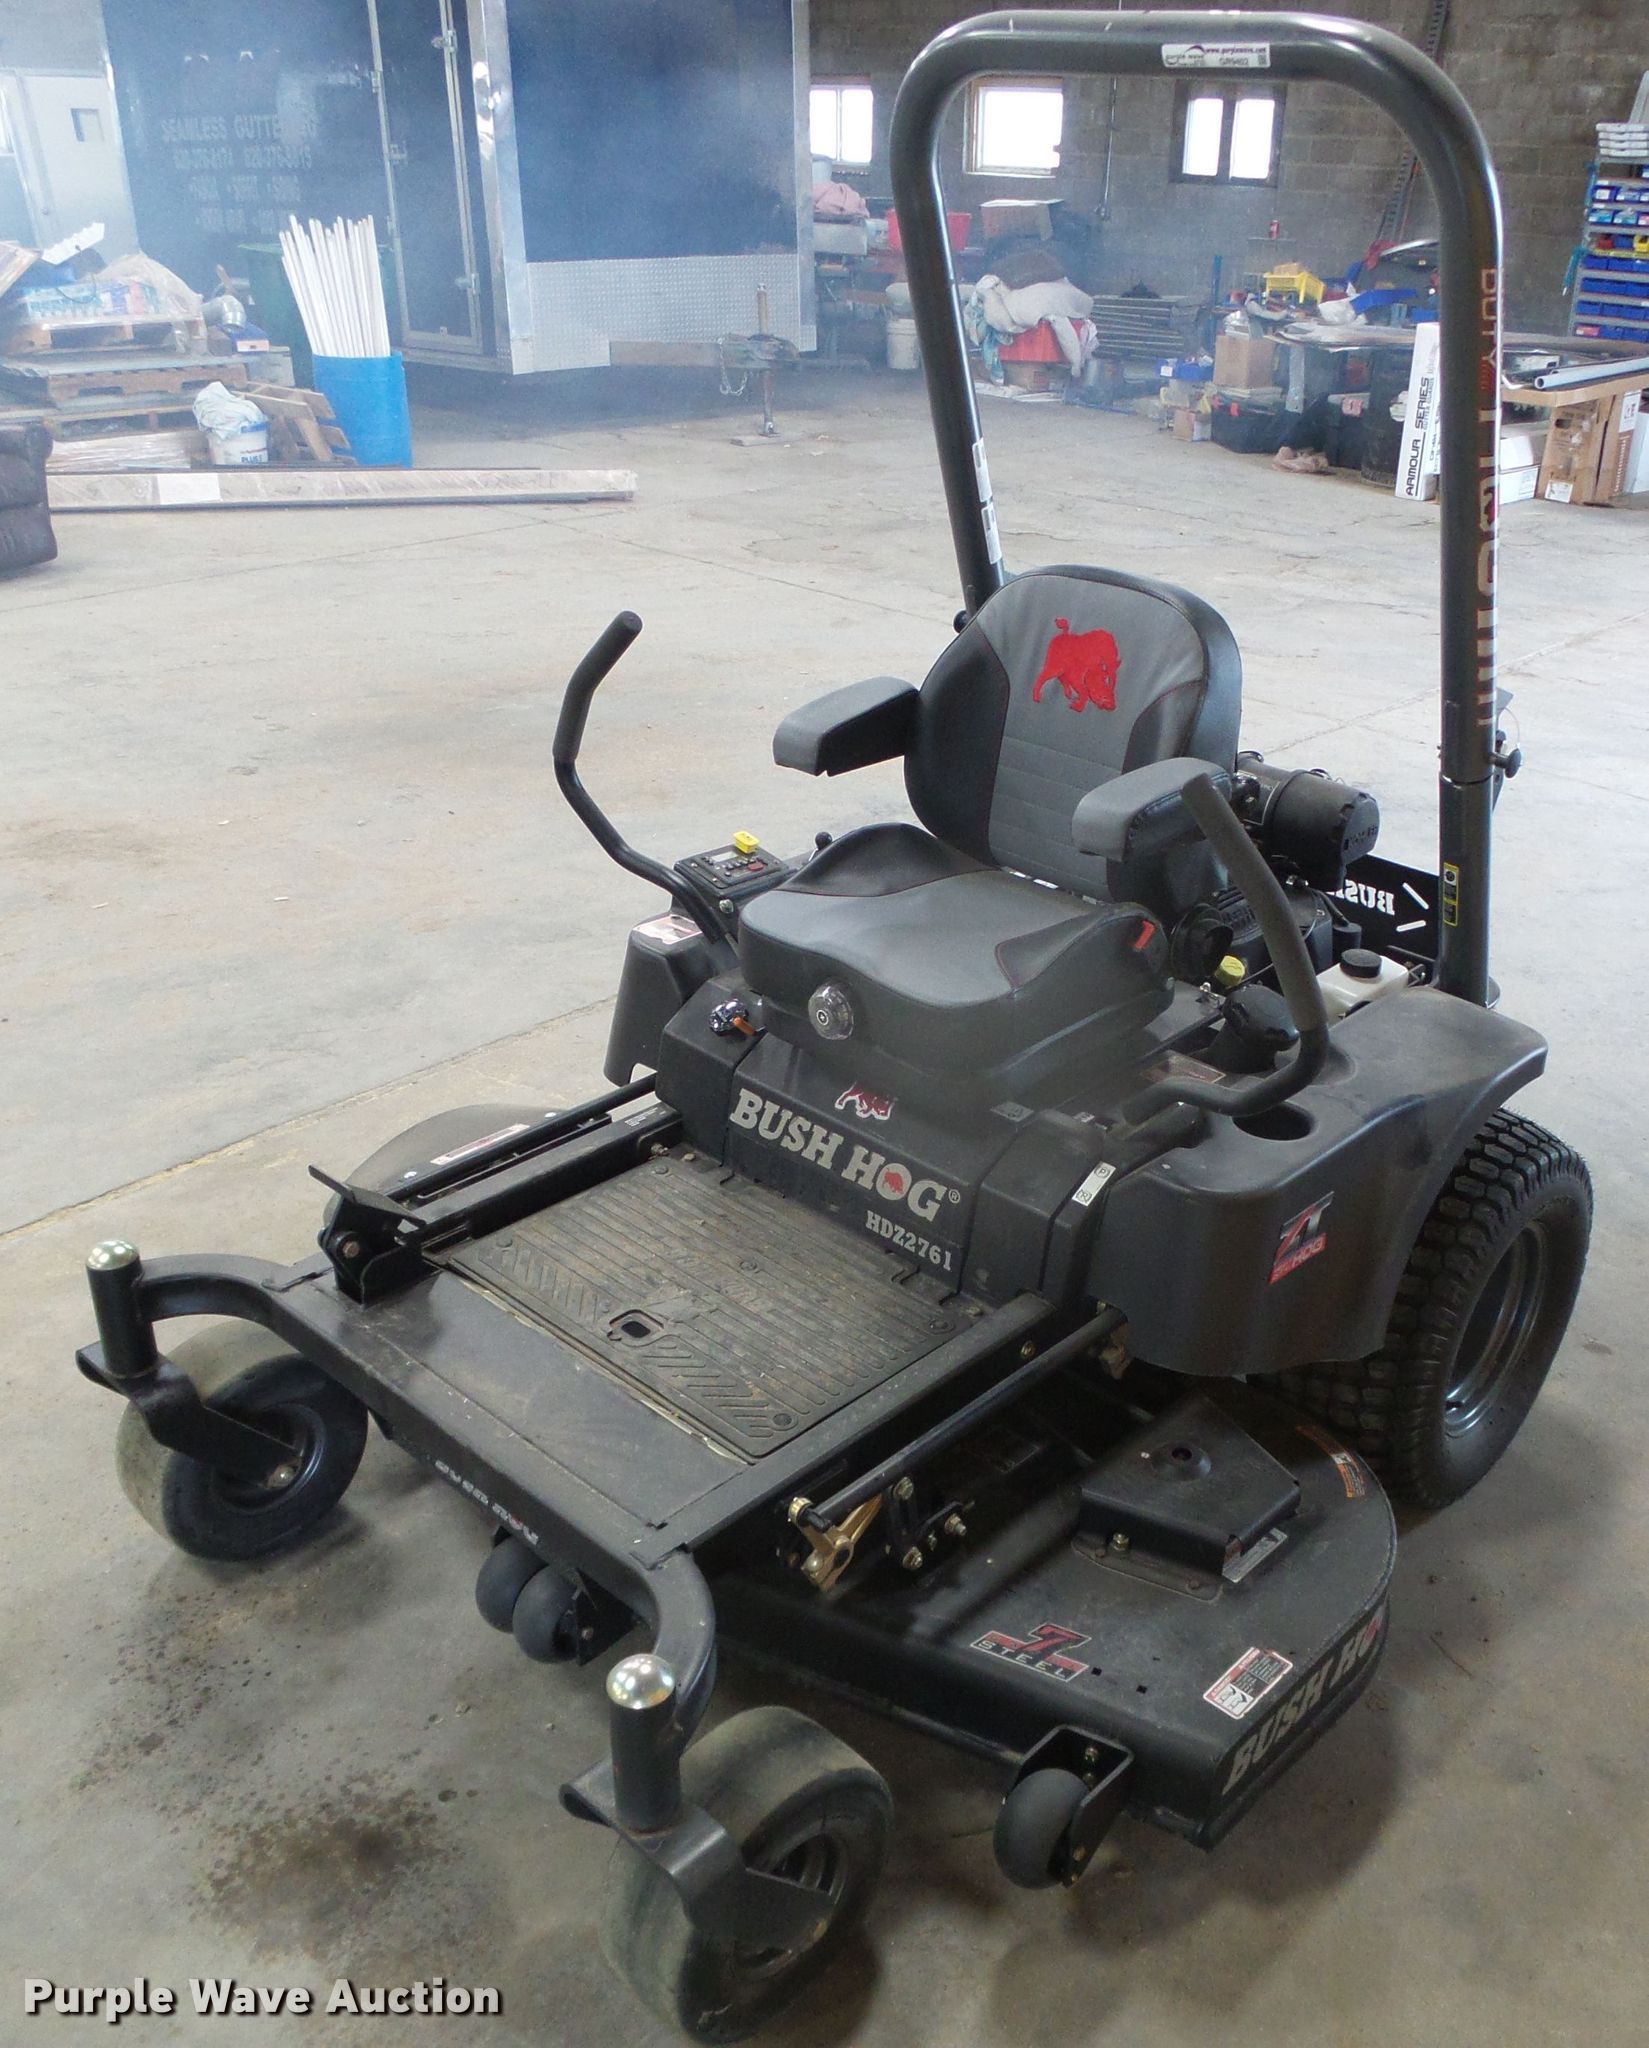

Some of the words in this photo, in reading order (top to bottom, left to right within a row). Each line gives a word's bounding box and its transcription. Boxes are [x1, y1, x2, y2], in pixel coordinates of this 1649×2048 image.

[161, 117, 227, 141] SEAMLESS
[1405, 438, 1421, 496] ARMOUR
[1414, 376, 1430, 430] SERIES
[729, 1088, 843, 1170] BUSH
[841, 1145, 947, 1222] HOG
[865, 1210, 953, 1273] HDZ2761
[978, 1639, 1066, 1679] STEEL
[1221, 1657, 1335, 1796] BUSH
